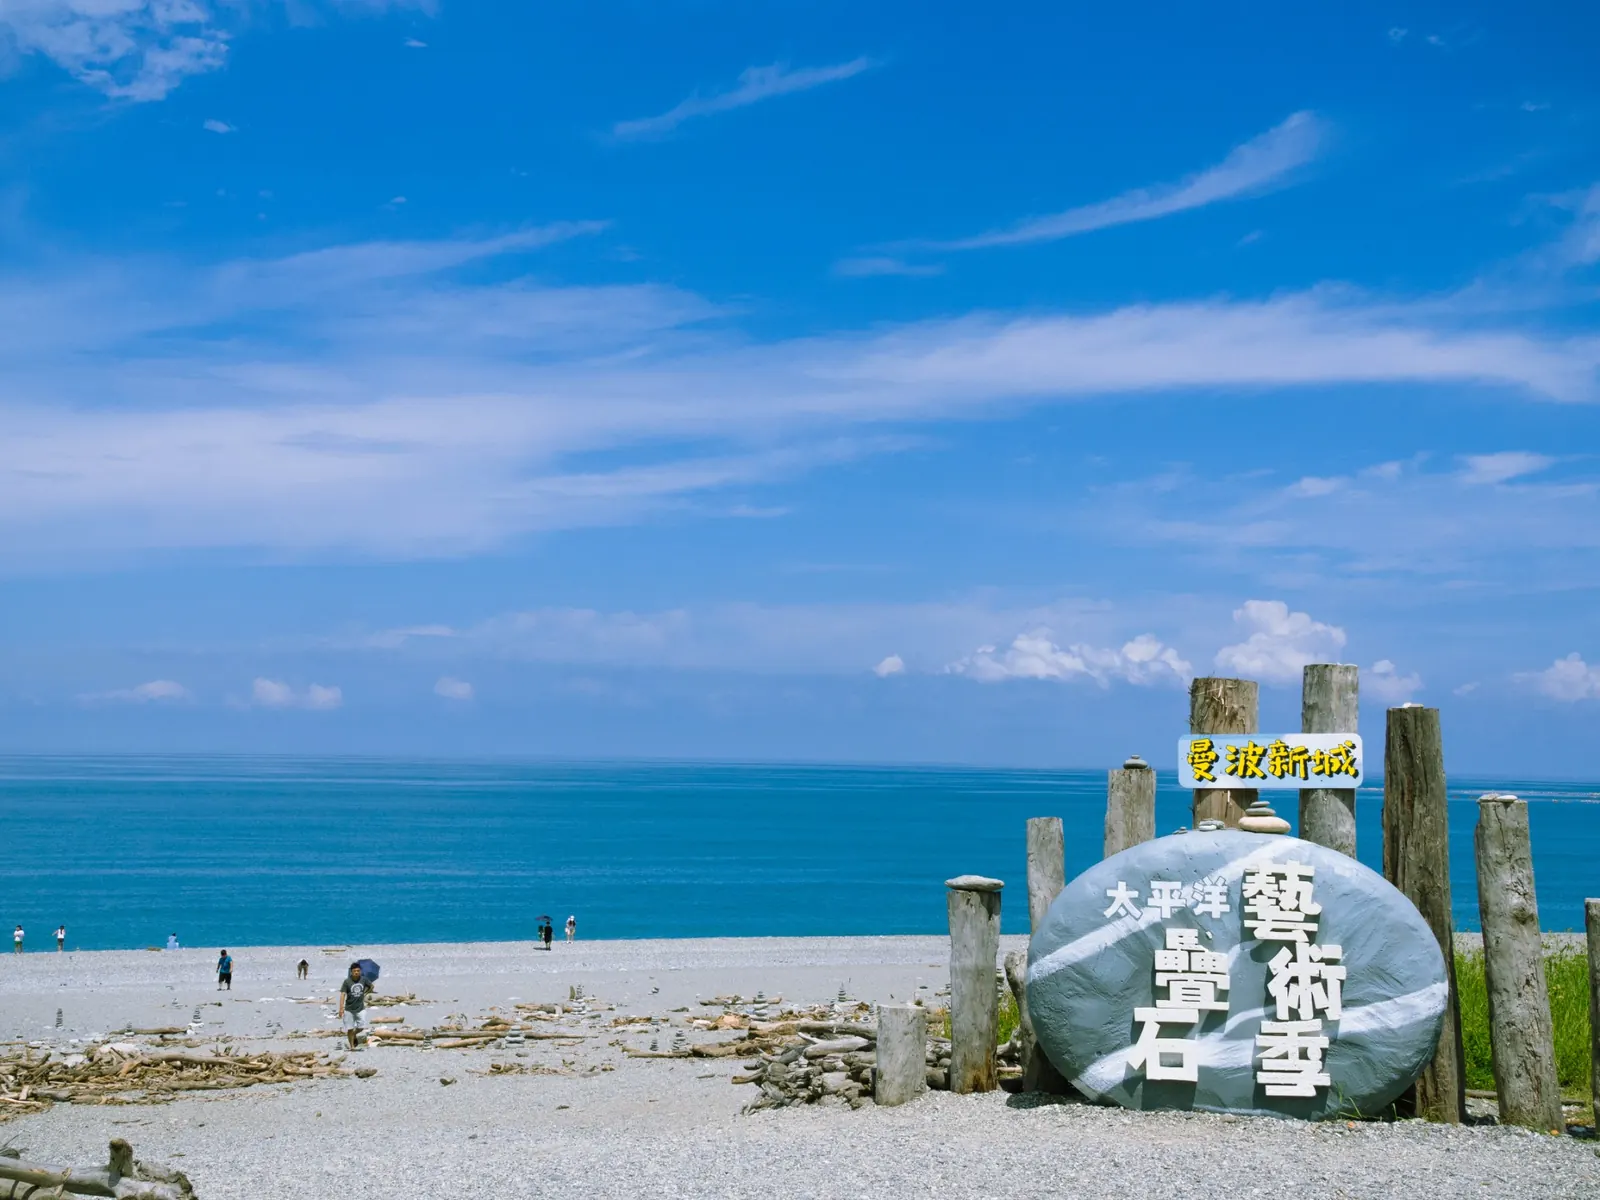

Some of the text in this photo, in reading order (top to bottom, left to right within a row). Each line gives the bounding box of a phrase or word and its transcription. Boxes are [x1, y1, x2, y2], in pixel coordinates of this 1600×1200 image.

[1187, 738, 1358, 781] 曼波新城
[1103, 876, 1230, 920] 太平洋
[1126, 928, 1230, 1082] 疊石
[1241, 860, 1347, 1097] 藝術季
